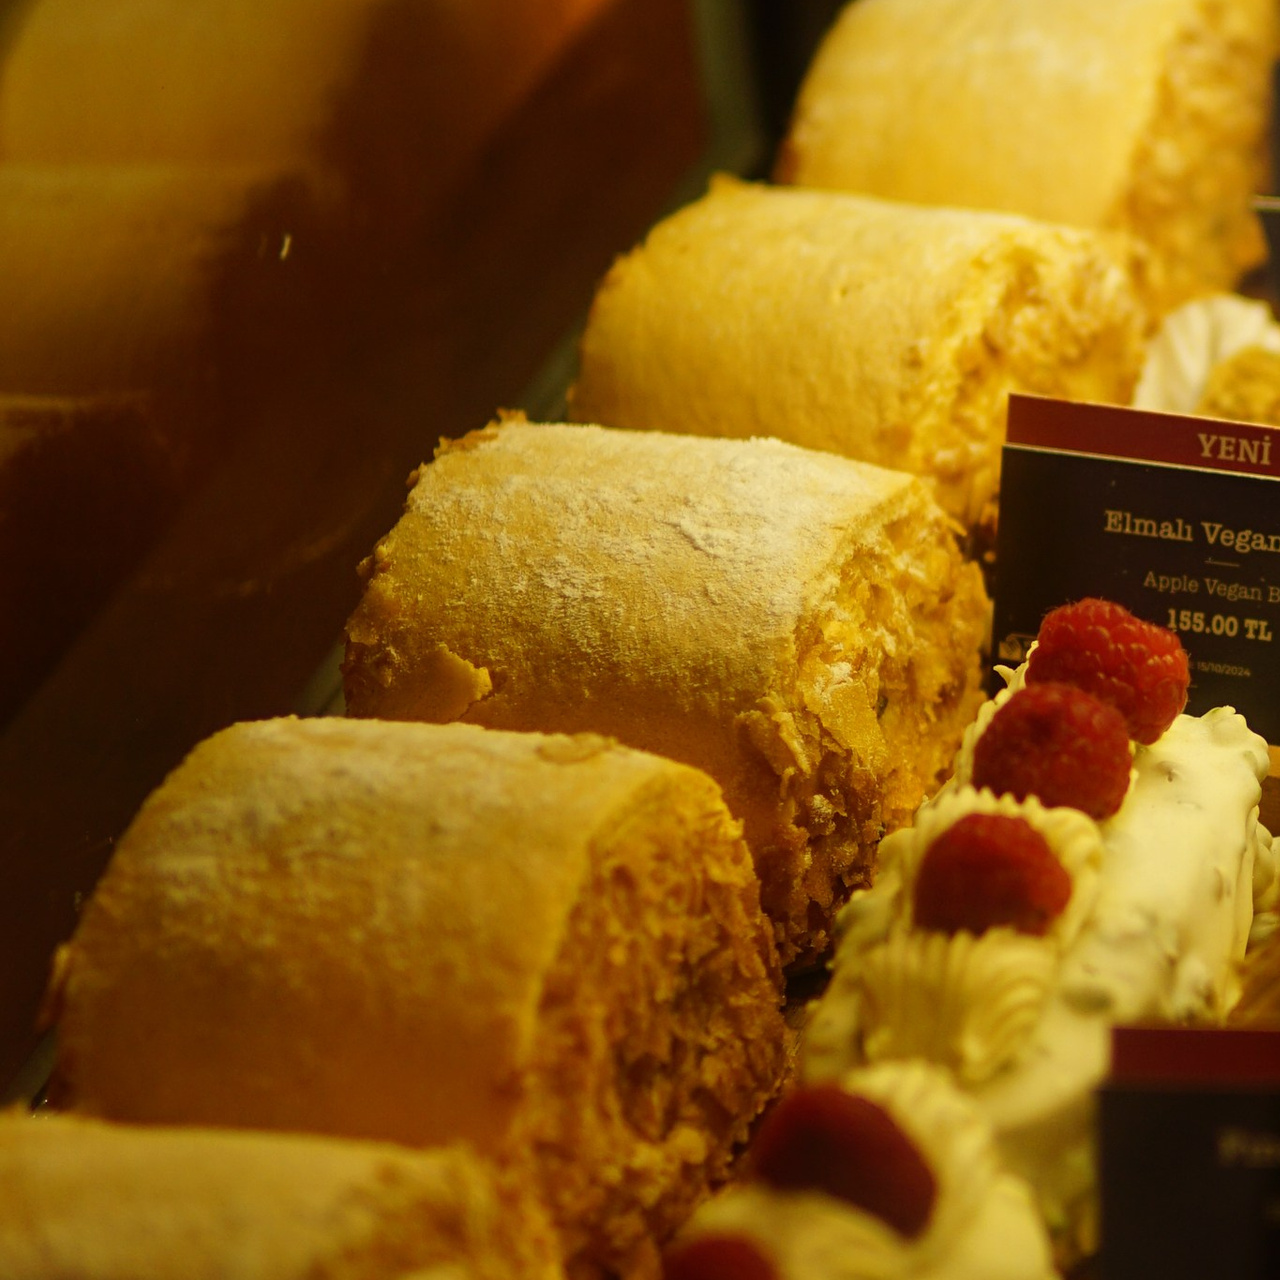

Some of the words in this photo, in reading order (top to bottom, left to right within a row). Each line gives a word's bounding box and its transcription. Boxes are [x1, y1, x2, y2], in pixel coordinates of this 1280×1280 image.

[1198, 433, 1272, 466] YENİ
[1103, 509, 1194, 543] Elmalı
[1143, 571, 1200, 594] Apple
[1204, 577, 1263, 602] Vegan
[1167, 608, 1239, 638] 155.00
[1244, 618, 1273, 642] TL
